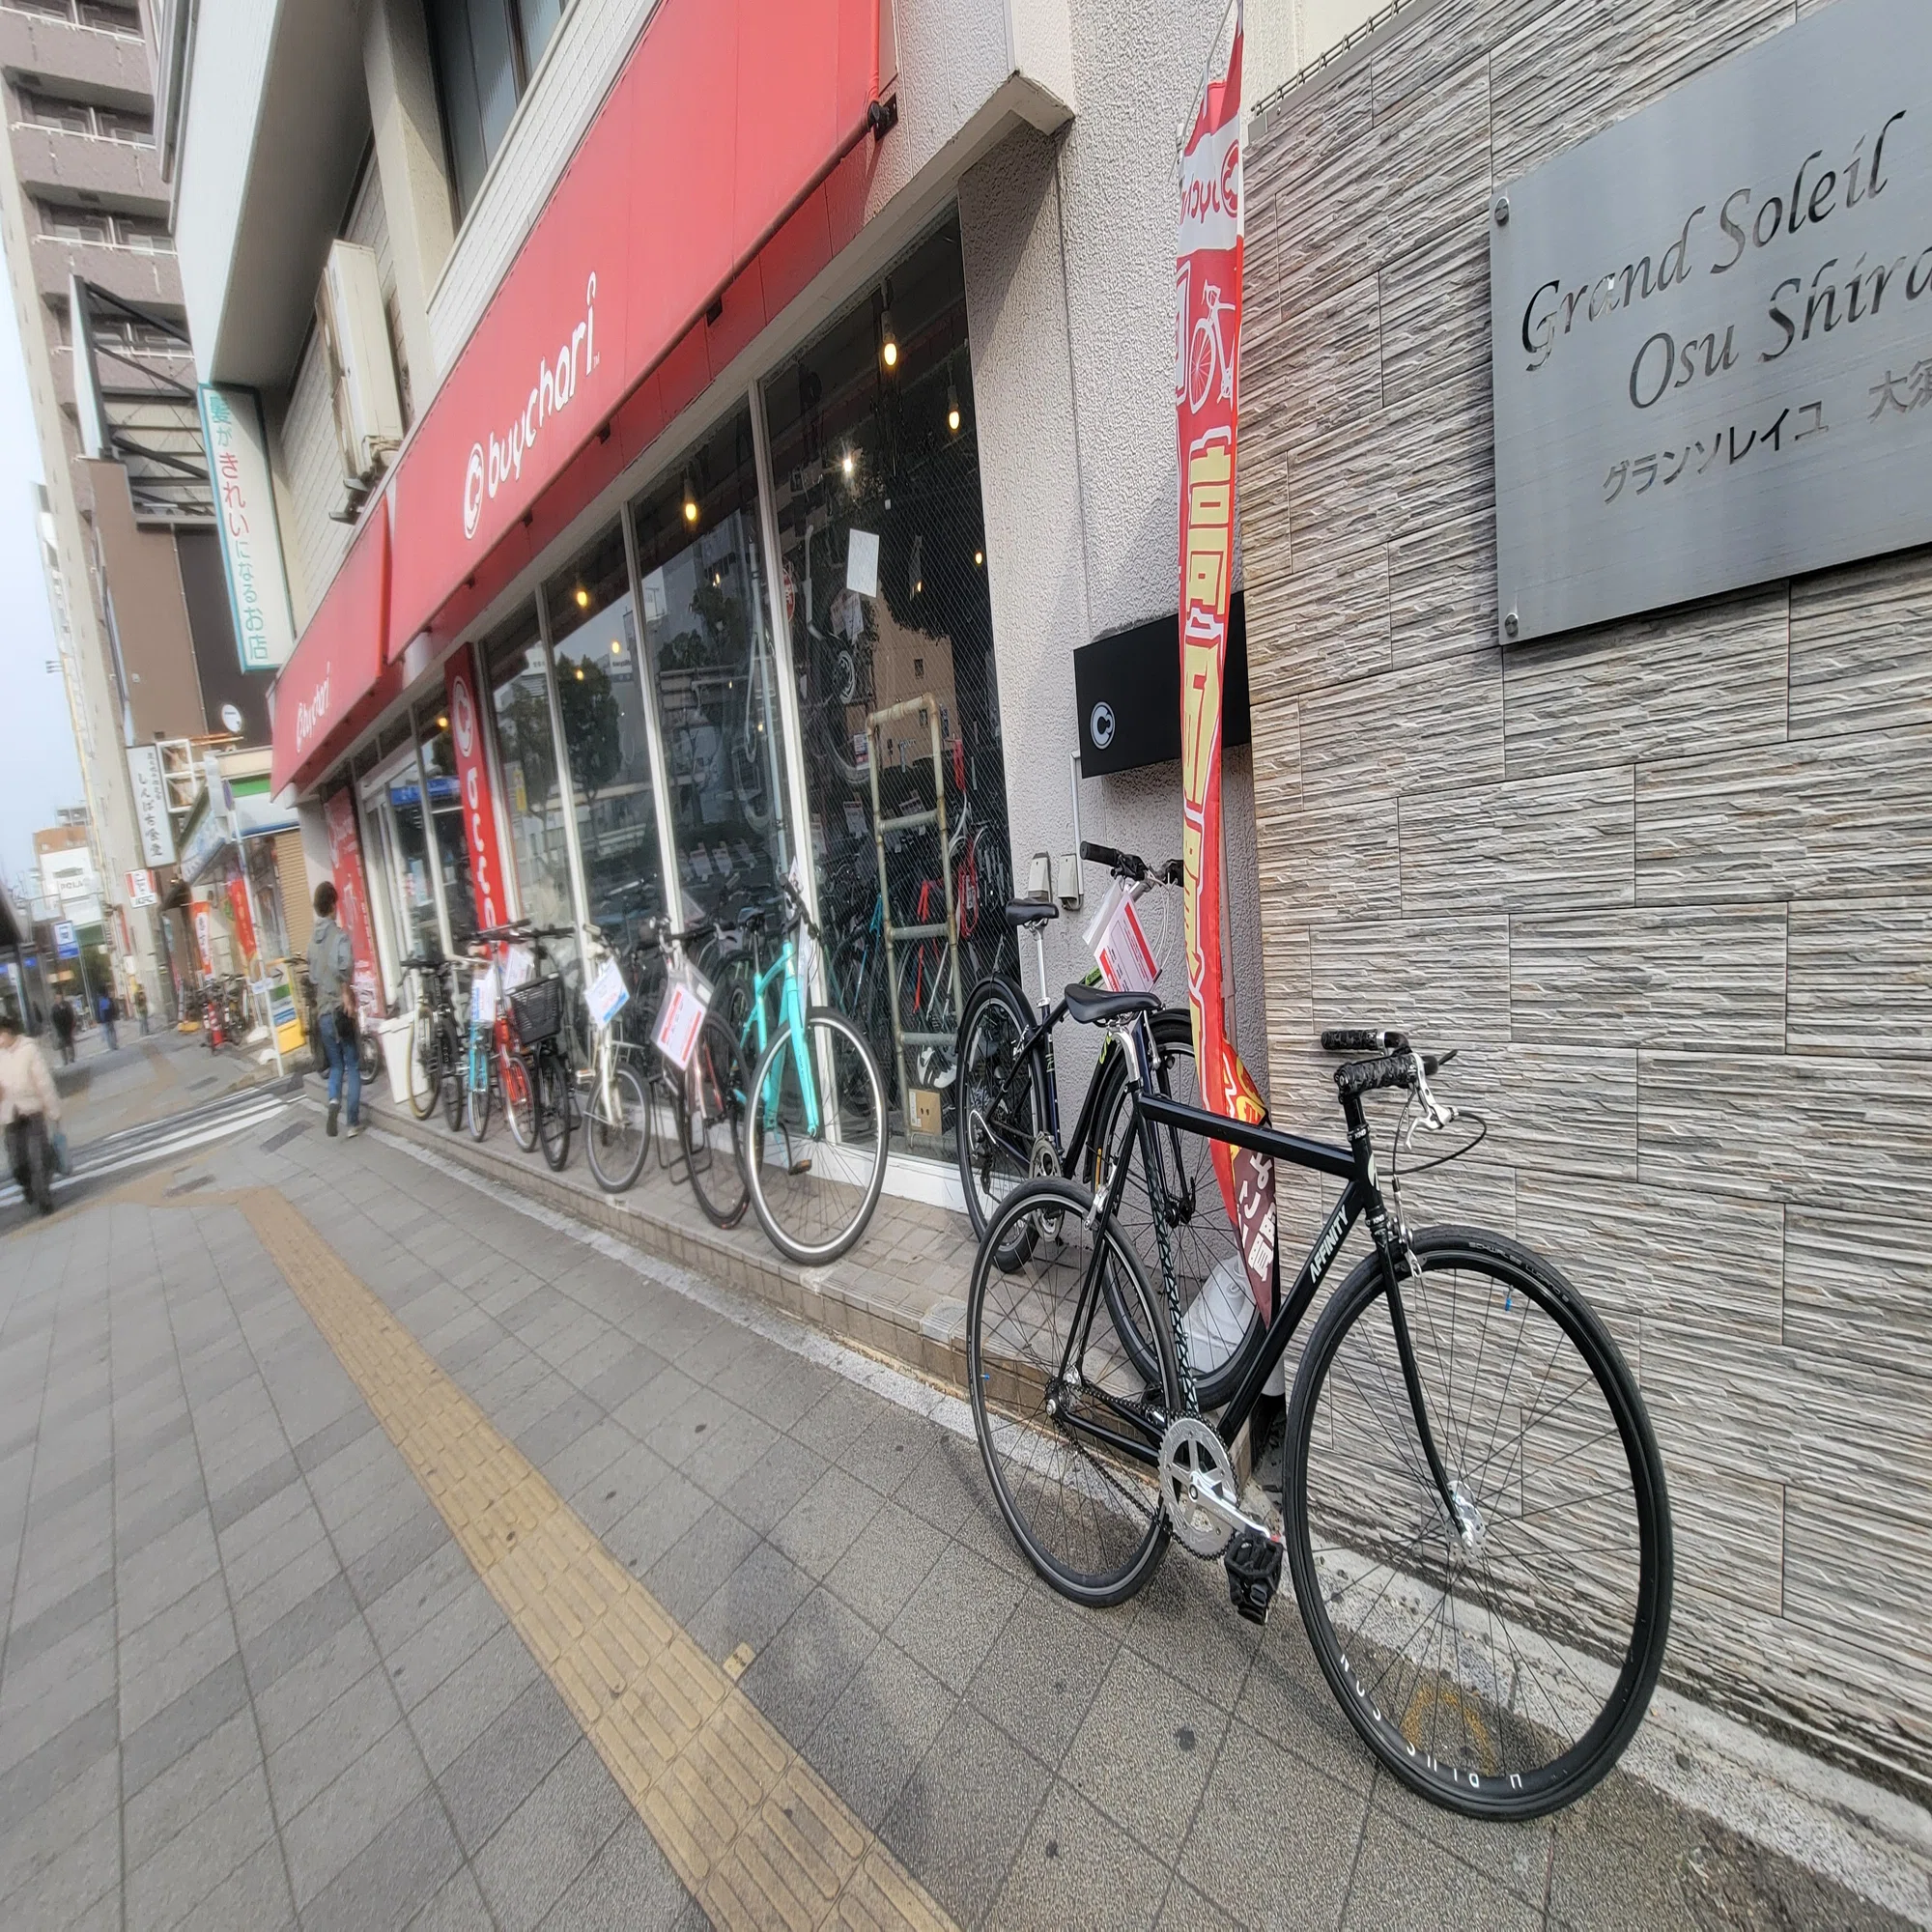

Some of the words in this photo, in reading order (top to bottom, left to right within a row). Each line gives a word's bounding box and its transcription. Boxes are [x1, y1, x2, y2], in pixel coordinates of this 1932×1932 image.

[1521, 206, 1706, 372] Grand
[1710, 110, 1907, 274] Soleil
[488, 270, 596, 499] buychari
[1629, 324, 1738, 410] Osu
[1604, 400, 1830, 504] グランソレイユ
[1309, 1205, 1350, 1285] AFFINITY
